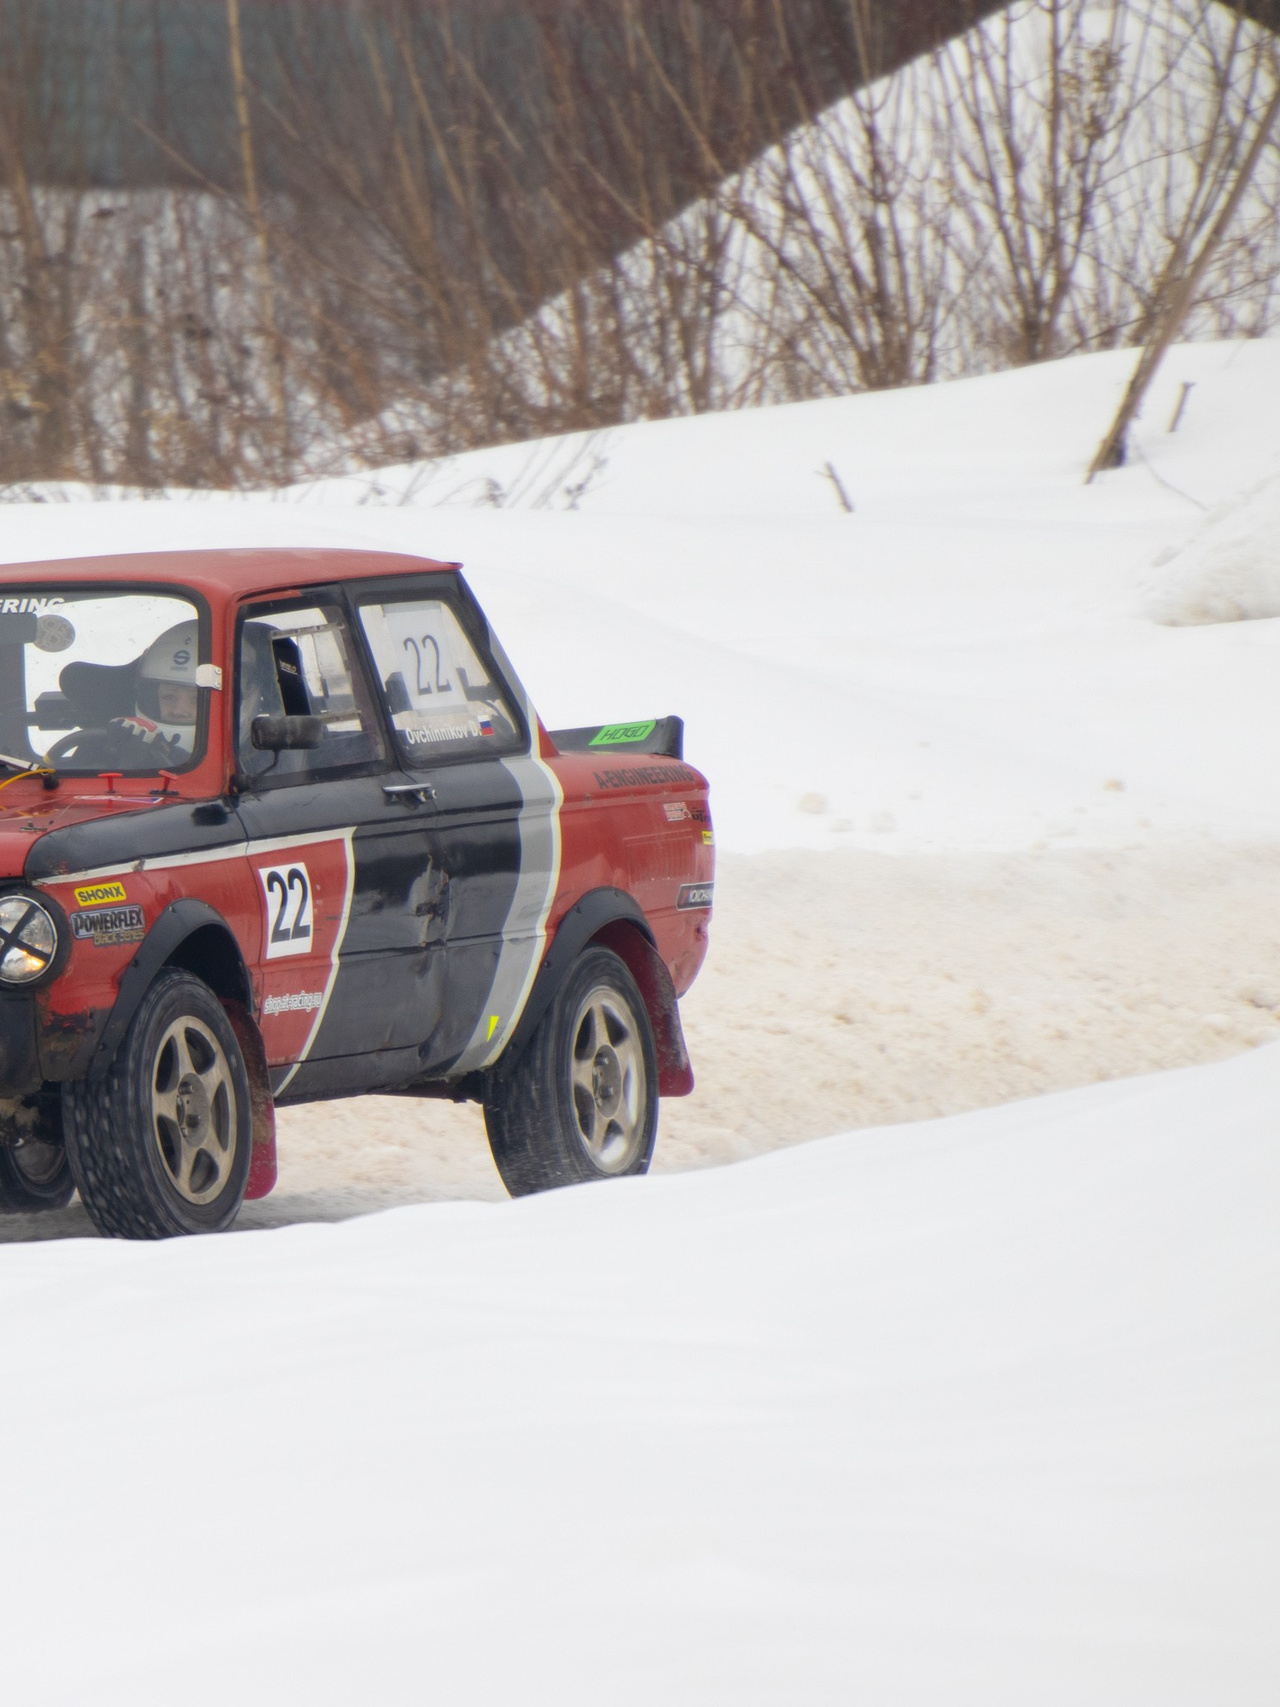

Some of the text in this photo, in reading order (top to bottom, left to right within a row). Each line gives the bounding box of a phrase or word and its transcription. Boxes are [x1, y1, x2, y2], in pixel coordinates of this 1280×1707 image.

[403, 634, 452, 696] 22
[405, 722, 468, 745] Ovchinnikov
[592, 765, 695, 790] A-ENGINEERING
[77, 886, 124, 903] SHONX
[266, 867, 312, 944] 22
[72, 908, 144, 937] POWERFLEX
